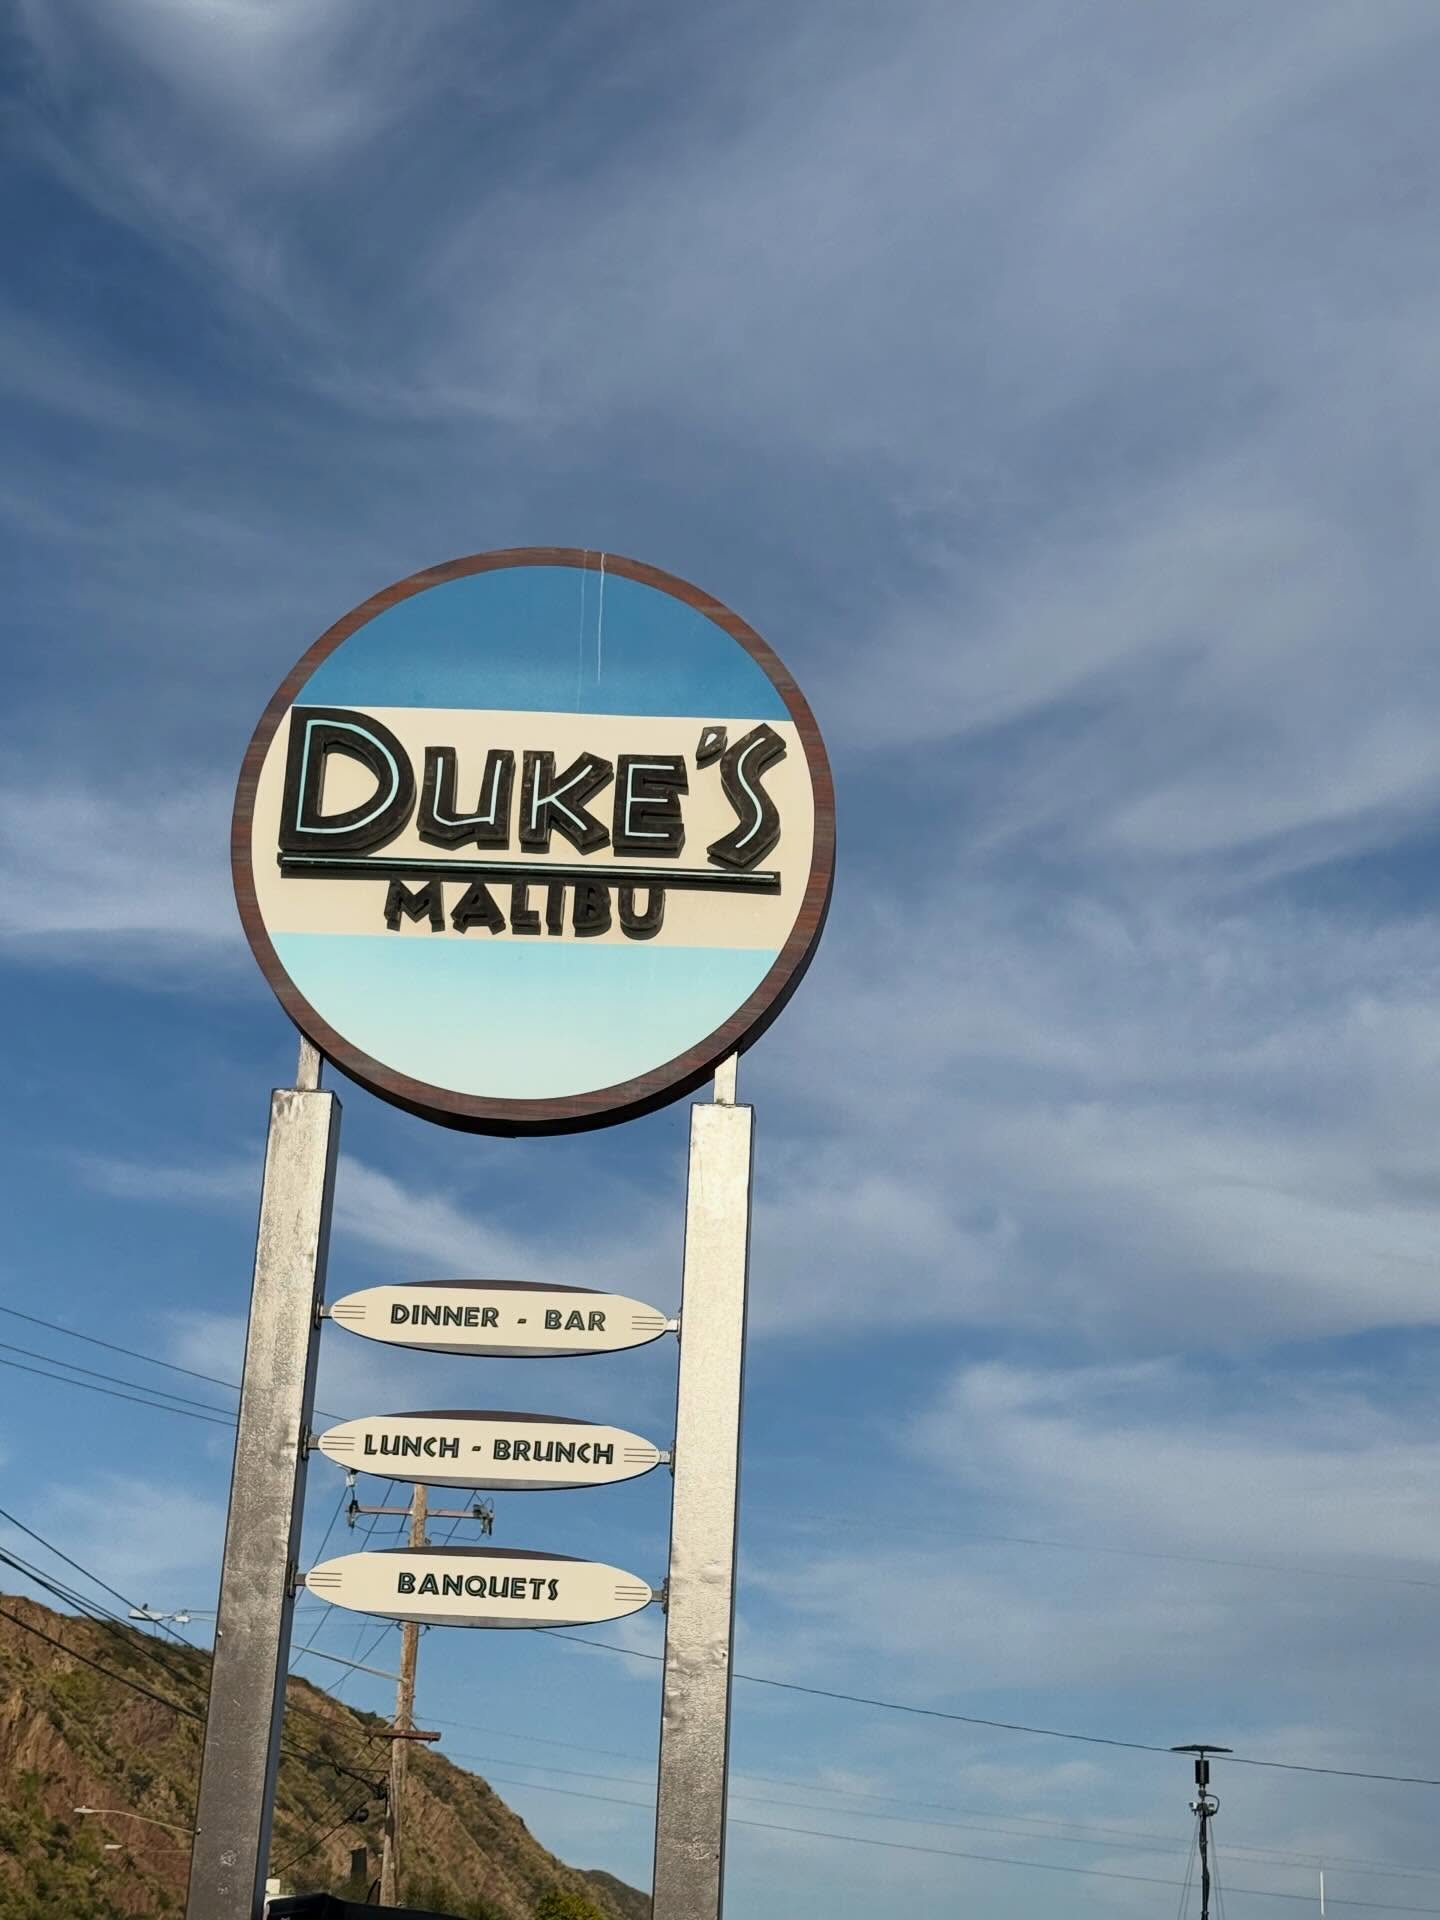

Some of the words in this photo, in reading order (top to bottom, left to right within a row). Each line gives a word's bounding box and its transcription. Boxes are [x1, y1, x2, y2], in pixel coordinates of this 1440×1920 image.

[278, 706, 787, 870] DUKE'S
[383, 879, 667, 940] MALIBU
[390, 1303, 499, 1328] DINNER
[544, 1309, 606, 1332] BAR
[364, 1434, 460, 1458] LUNCH
[493, 1439, 615, 1465] BRUNCH
[397, 1572, 559, 1601] BANQUETS
